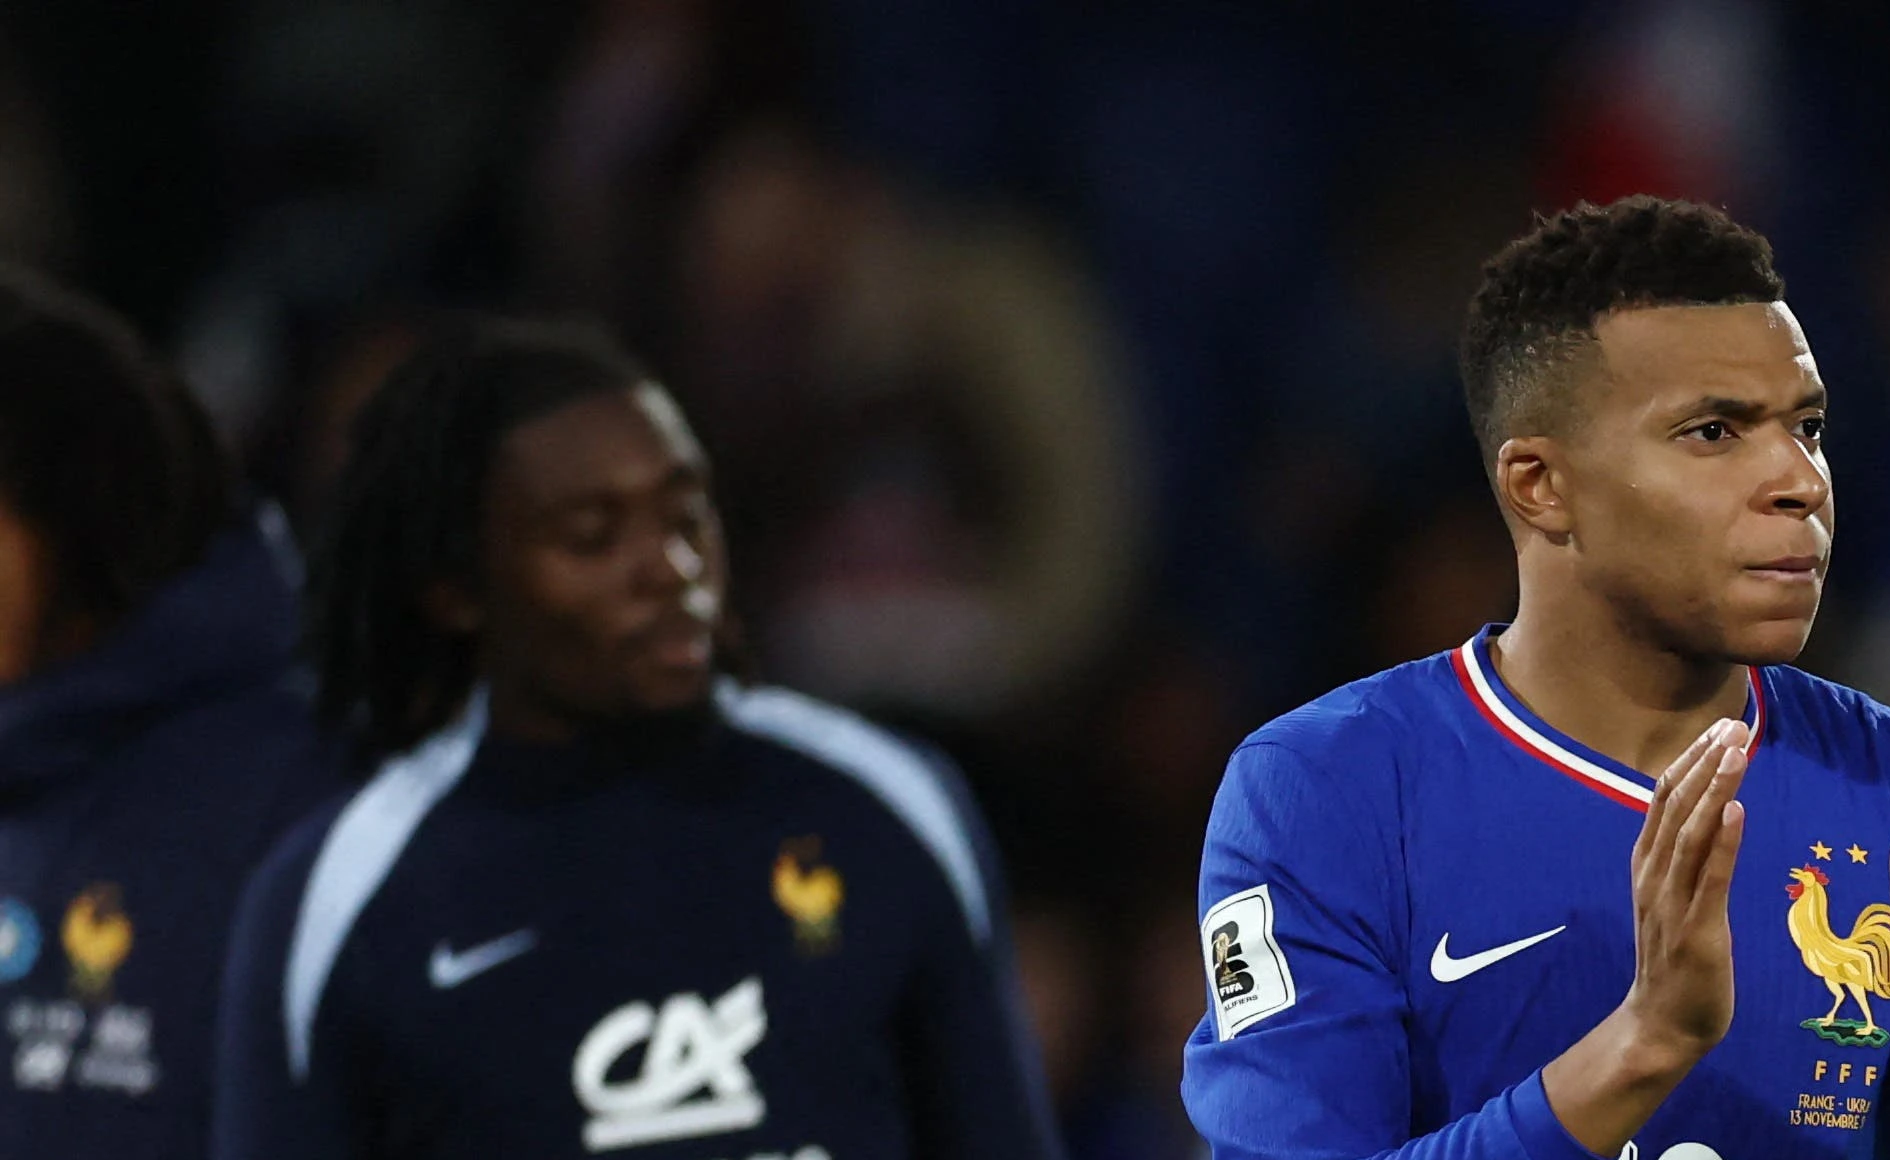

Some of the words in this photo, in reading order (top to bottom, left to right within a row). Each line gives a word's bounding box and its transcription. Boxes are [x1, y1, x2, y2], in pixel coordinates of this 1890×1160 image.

[1220, 982, 1244, 997] FIFA
[1799, 1093, 1835, 1111] FRANCE
[1790, 1110, 1801, 1125] 13
[1804, 1111, 1860, 1130] NOVEMBRE
